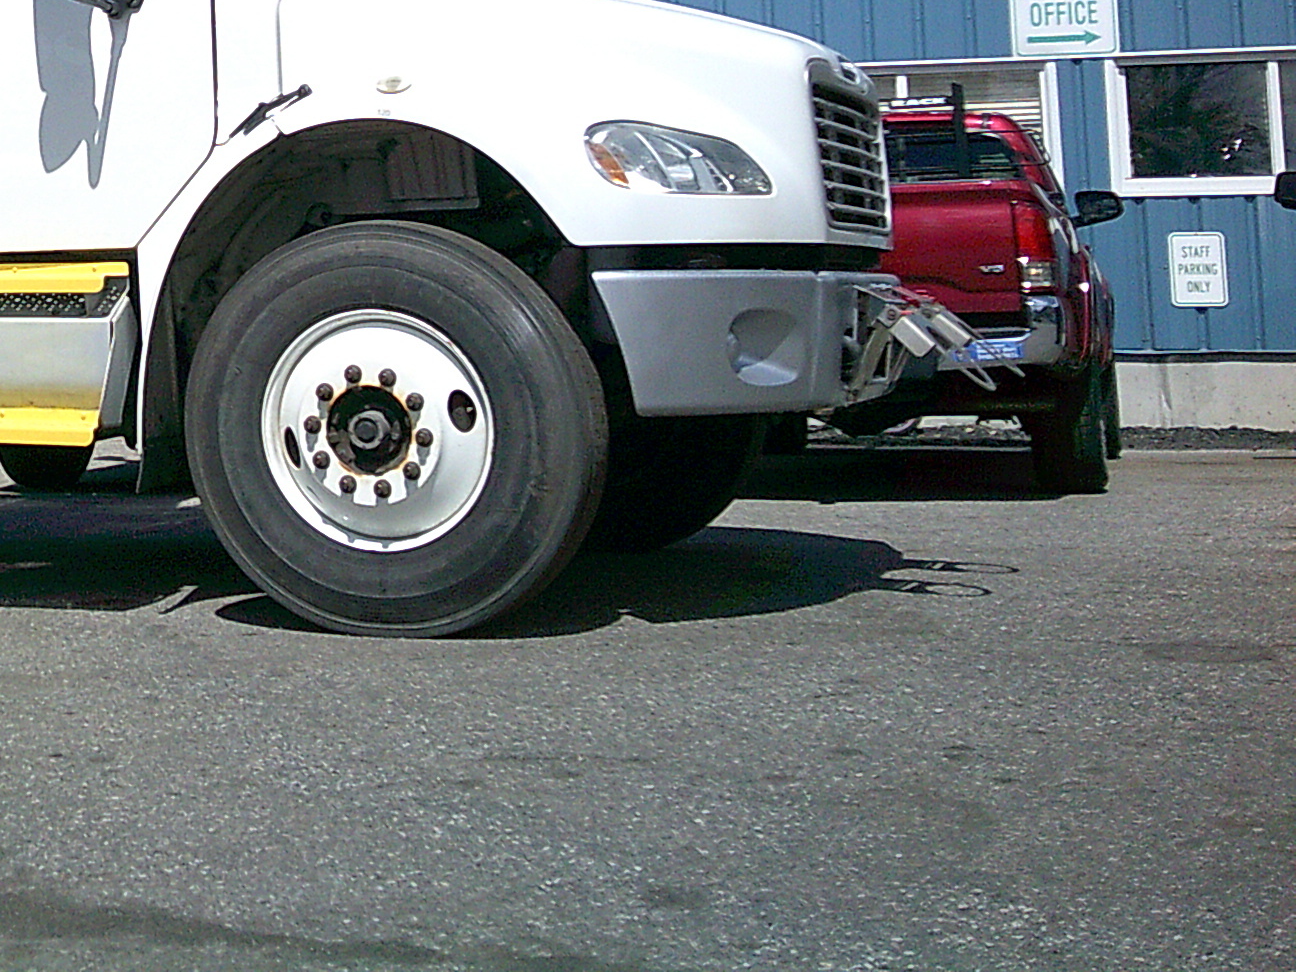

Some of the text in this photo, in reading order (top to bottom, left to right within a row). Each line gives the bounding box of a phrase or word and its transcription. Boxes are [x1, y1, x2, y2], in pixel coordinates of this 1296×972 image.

[1030, 0, 1099, 27] OFFICE
[1181, 245, 1210, 259] STAFF
[1177, 262, 1218, 276] PARKING
[1187, 280, 1211, 293] ONLY
